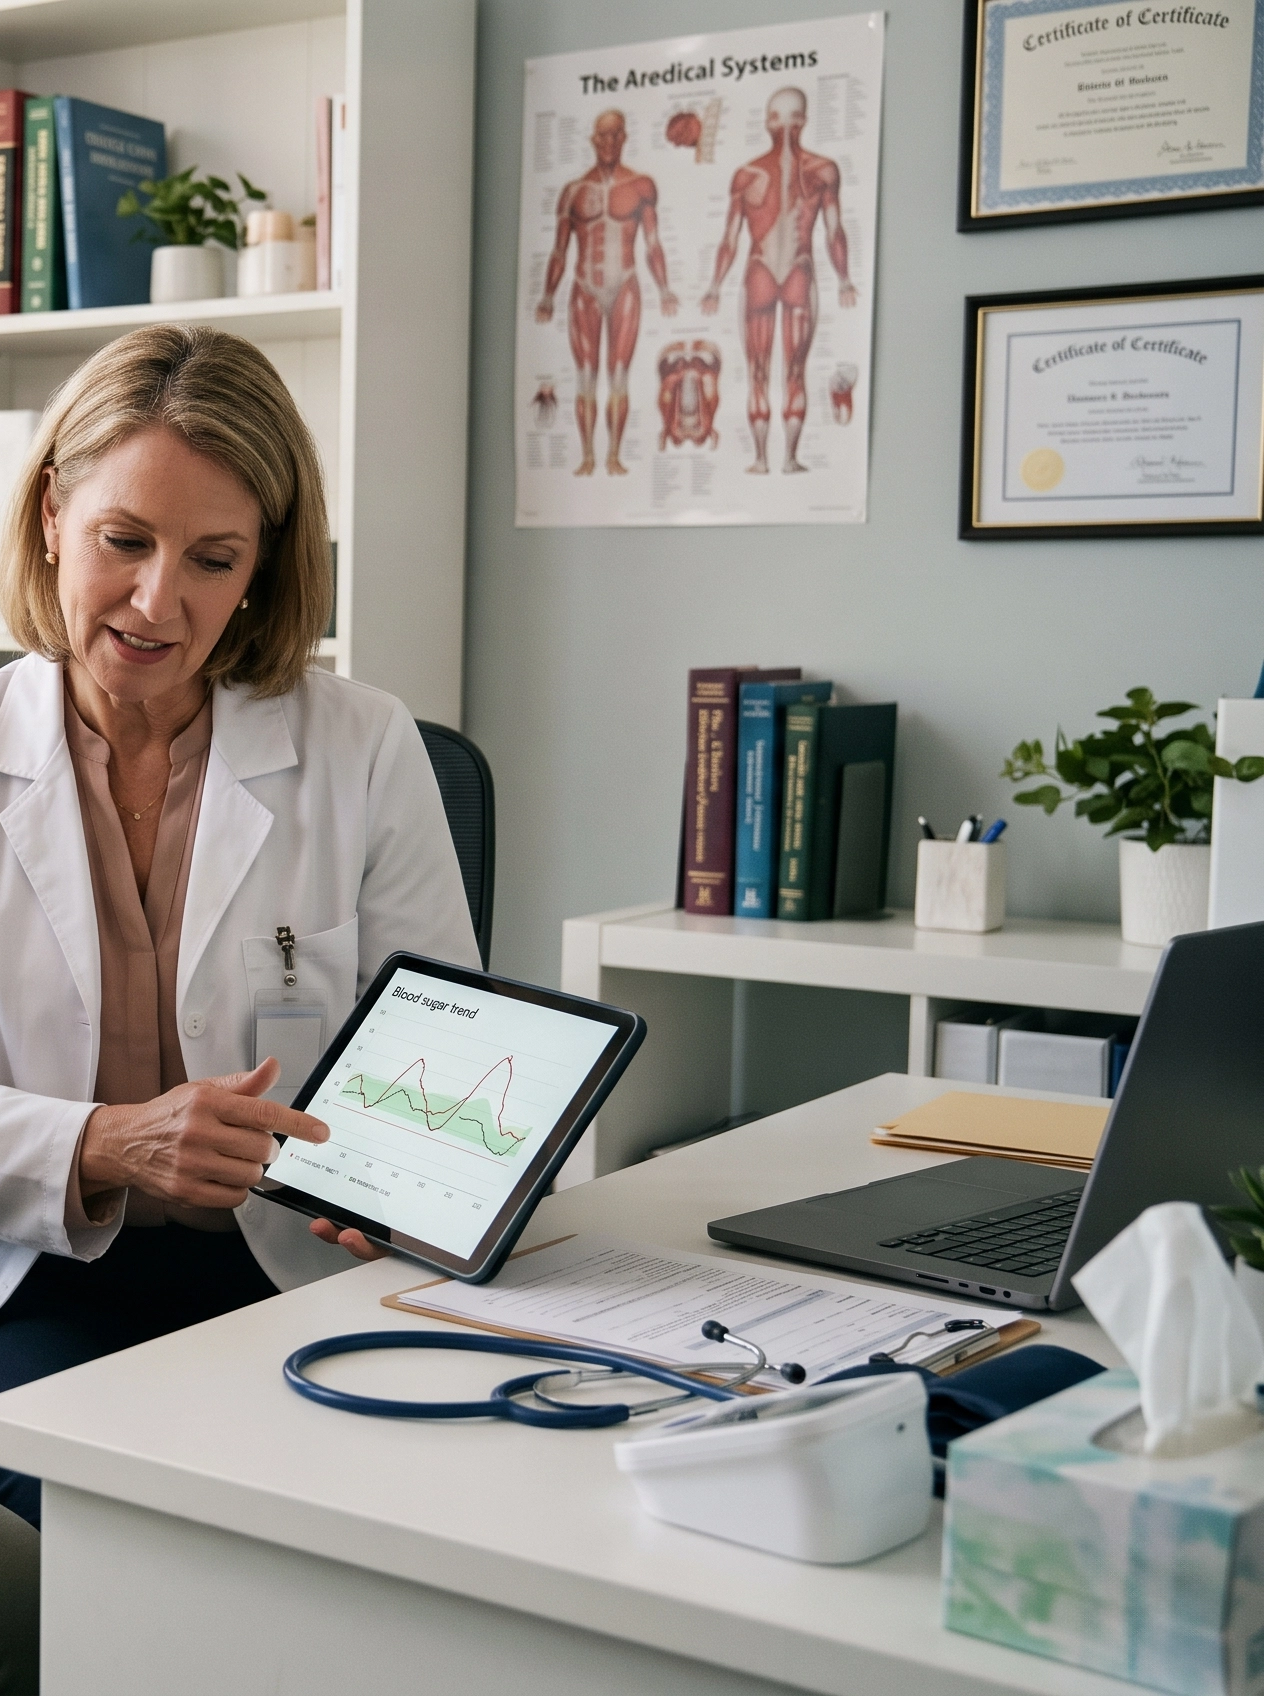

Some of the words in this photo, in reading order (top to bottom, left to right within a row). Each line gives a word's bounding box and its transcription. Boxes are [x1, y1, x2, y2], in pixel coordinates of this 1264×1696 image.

[1023, 17, 1109, 51] Certificate
[1115, 10, 1133, 28] of
[1137, 6, 1230, 29] Certificate
[579, 73, 620, 95] The
[624, 58, 715, 89] Aredical
[721, 51, 818, 81] Systems
[1032, 343, 1107, 373] Certificate
[1111, 336, 1127, 351] of
[1130, 337, 1208, 365] Certificate
[392, 986, 423, 1003] Blood
[420, 996, 450, 1011] sugar
[449, 1003, 479, 1019] trend
